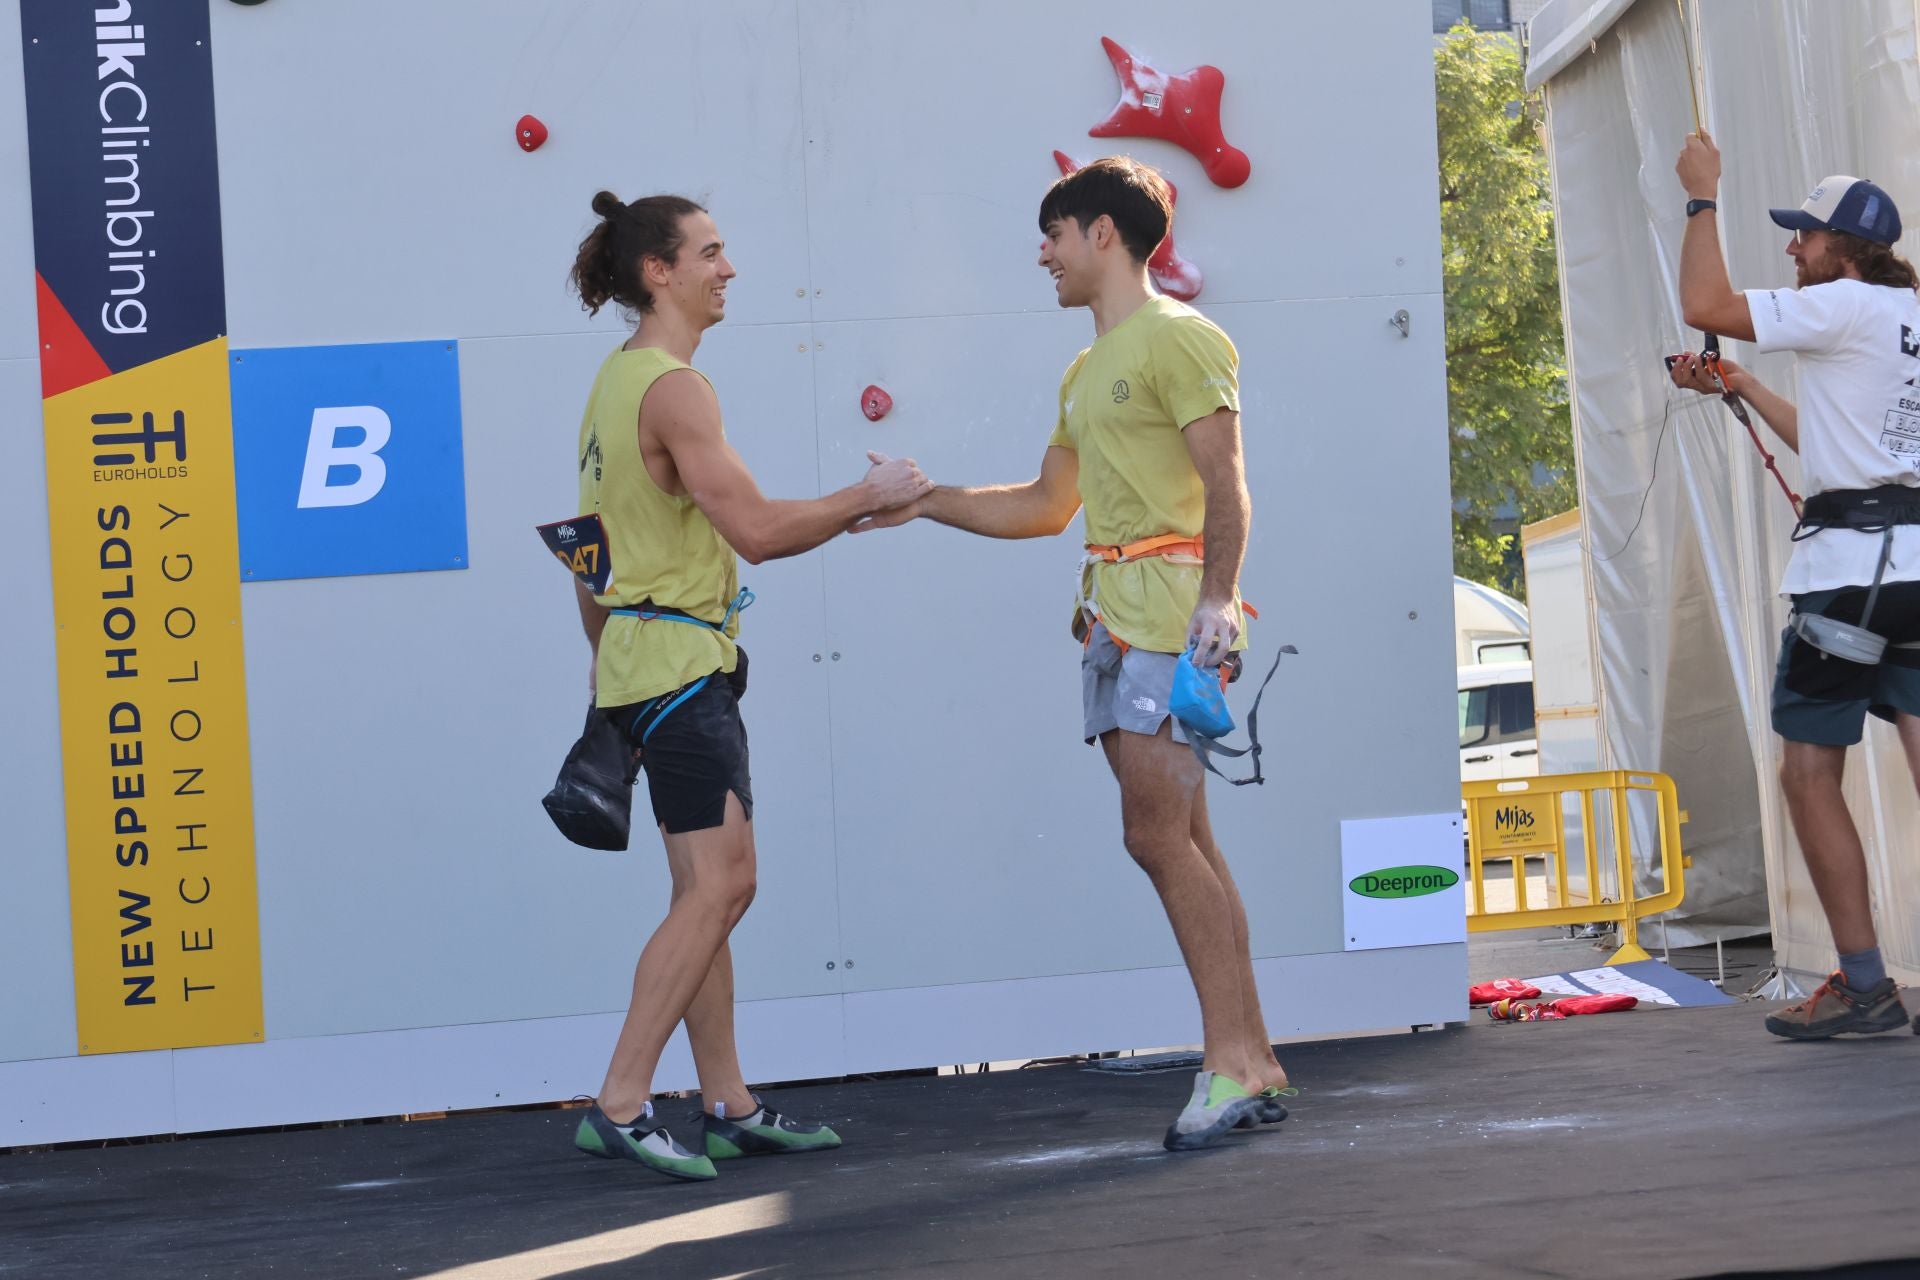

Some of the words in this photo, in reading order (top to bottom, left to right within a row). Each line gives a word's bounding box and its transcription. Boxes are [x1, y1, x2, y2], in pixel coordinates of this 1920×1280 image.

[93, 466, 188, 482] EUROHOLDS
[297, 405, 392, 509] B
[1894, 414, 1920, 434] BLO
[98, 504, 138, 678] HOLDS
[109, 702, 148, 867] SPEED
[159, 503, 215, 1002] TECHNOLOGY
[1495, 805, 1535, 833] Mijas
[1364, 874, 1444, 894] Deepron
[119, 890, 156, 1006] NEW
